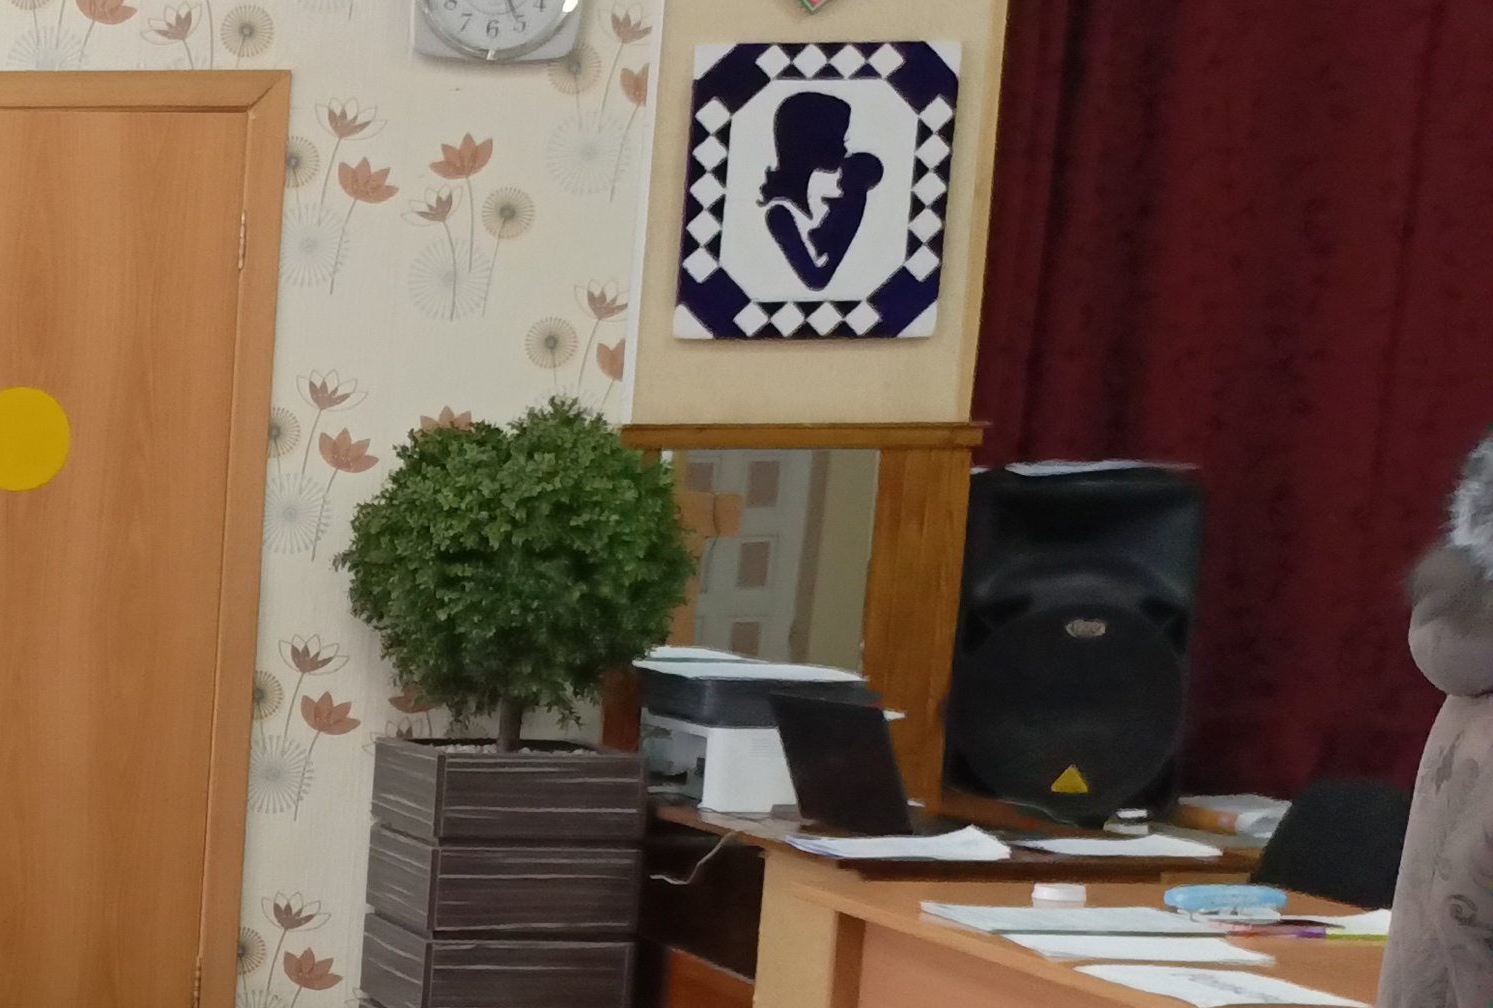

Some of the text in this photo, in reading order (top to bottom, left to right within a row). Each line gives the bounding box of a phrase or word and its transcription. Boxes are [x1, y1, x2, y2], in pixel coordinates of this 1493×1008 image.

[458, 13, 473, 34] 7
[485, 19, 500, 39] 6
[512, 14, 527, 33] 5
